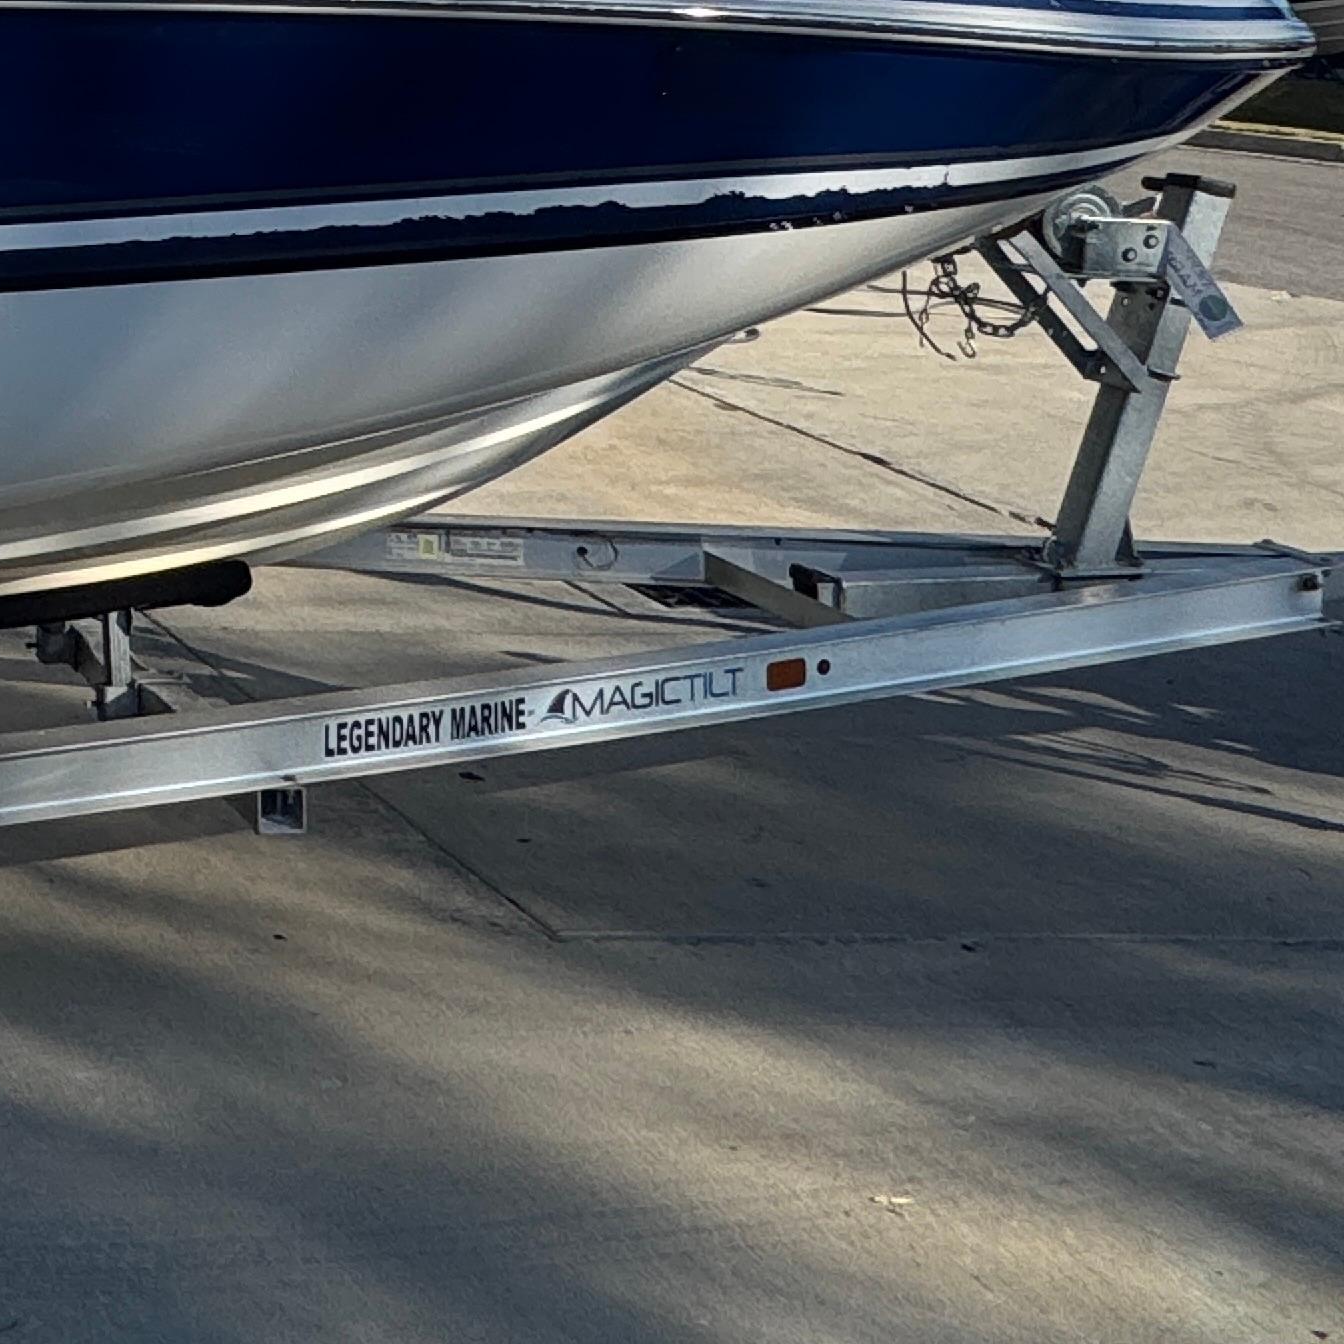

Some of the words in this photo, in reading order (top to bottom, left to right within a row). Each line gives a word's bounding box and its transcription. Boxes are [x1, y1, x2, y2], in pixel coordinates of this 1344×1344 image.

[571, 666, 745, 723] MAGICTILT
[323, 708, 445, 758] LEGENDARY
[449, 696, 527, 741] MARINE
